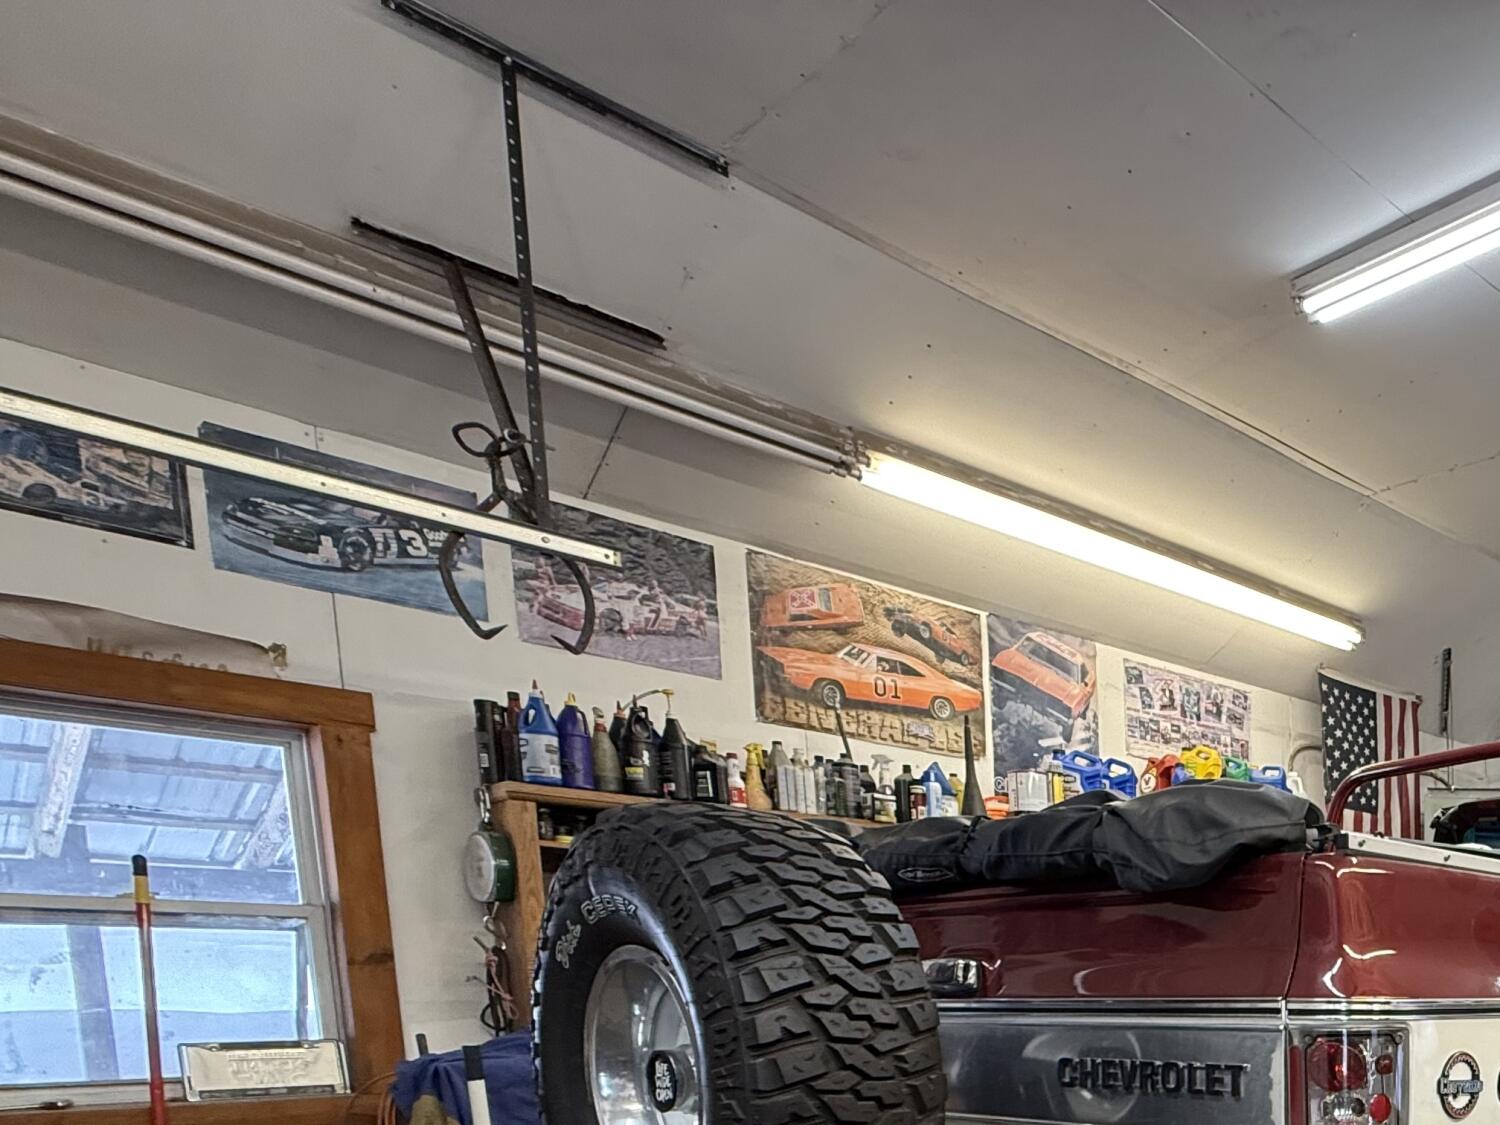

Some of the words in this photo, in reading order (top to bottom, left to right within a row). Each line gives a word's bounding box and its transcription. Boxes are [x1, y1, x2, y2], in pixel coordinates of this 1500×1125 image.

[398, 528, 428, 558] 3
[873, 675, 901, 700] 01
[1057, 1056, 1250, 1100] CHEVROLET
